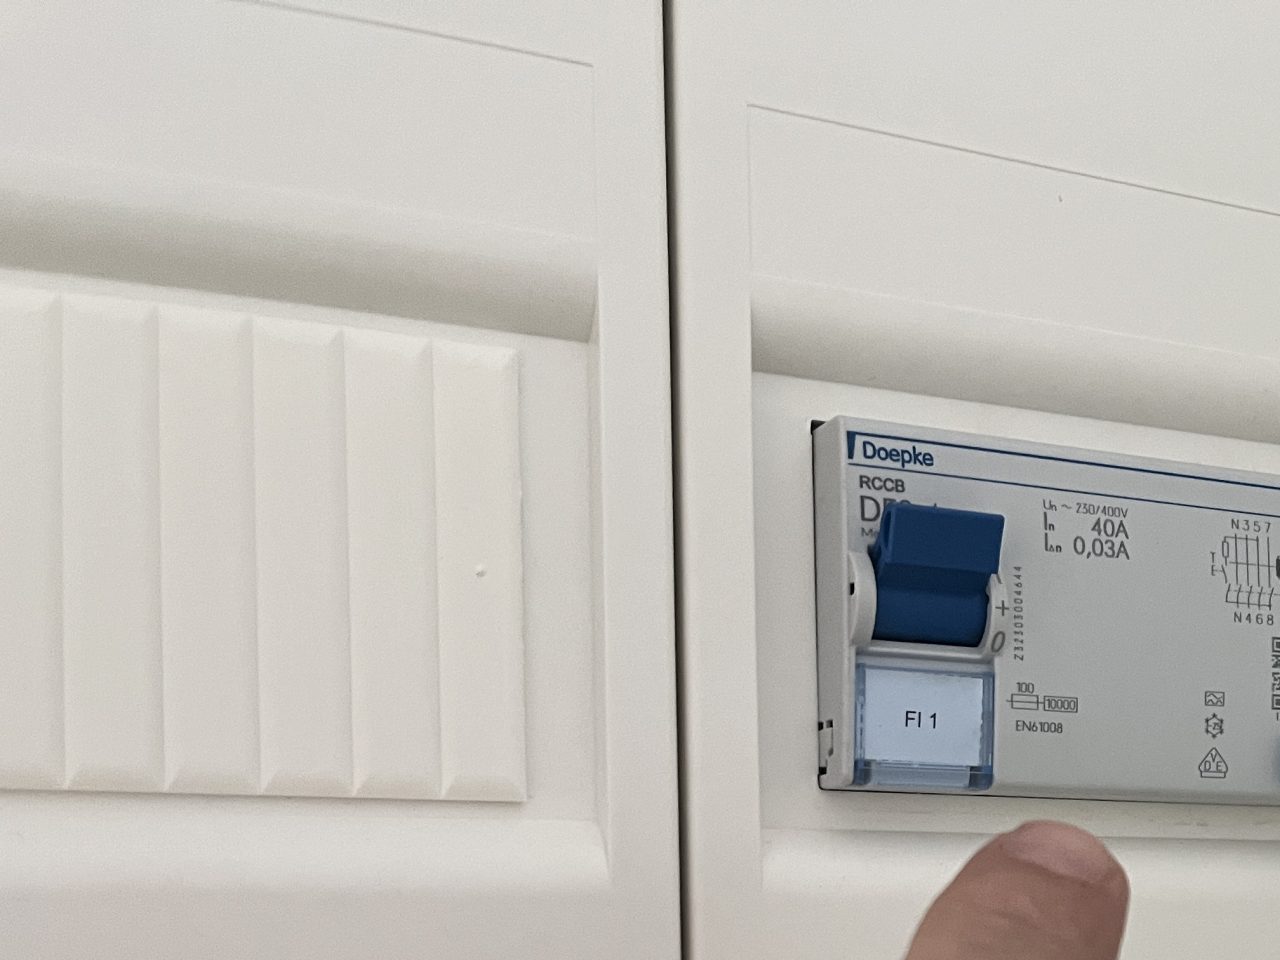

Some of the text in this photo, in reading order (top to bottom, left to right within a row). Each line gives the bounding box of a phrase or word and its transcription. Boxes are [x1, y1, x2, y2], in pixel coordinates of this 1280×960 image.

[863, 441, 934, 468] Doepke
[859, 475, 905, 492] RCCB
[1076, 502, 1128, 518] 230/400V
[1091, 517, 1129, 539] 40A
[1073, 536, 1130, 560] 0,03A
[1016, 682, 1034, 694] 100
[1046, 699, 1076, 711] 10000
[905, 710, 937, 729] FI 1
[1015, 720, 1063, 733] EN61008
